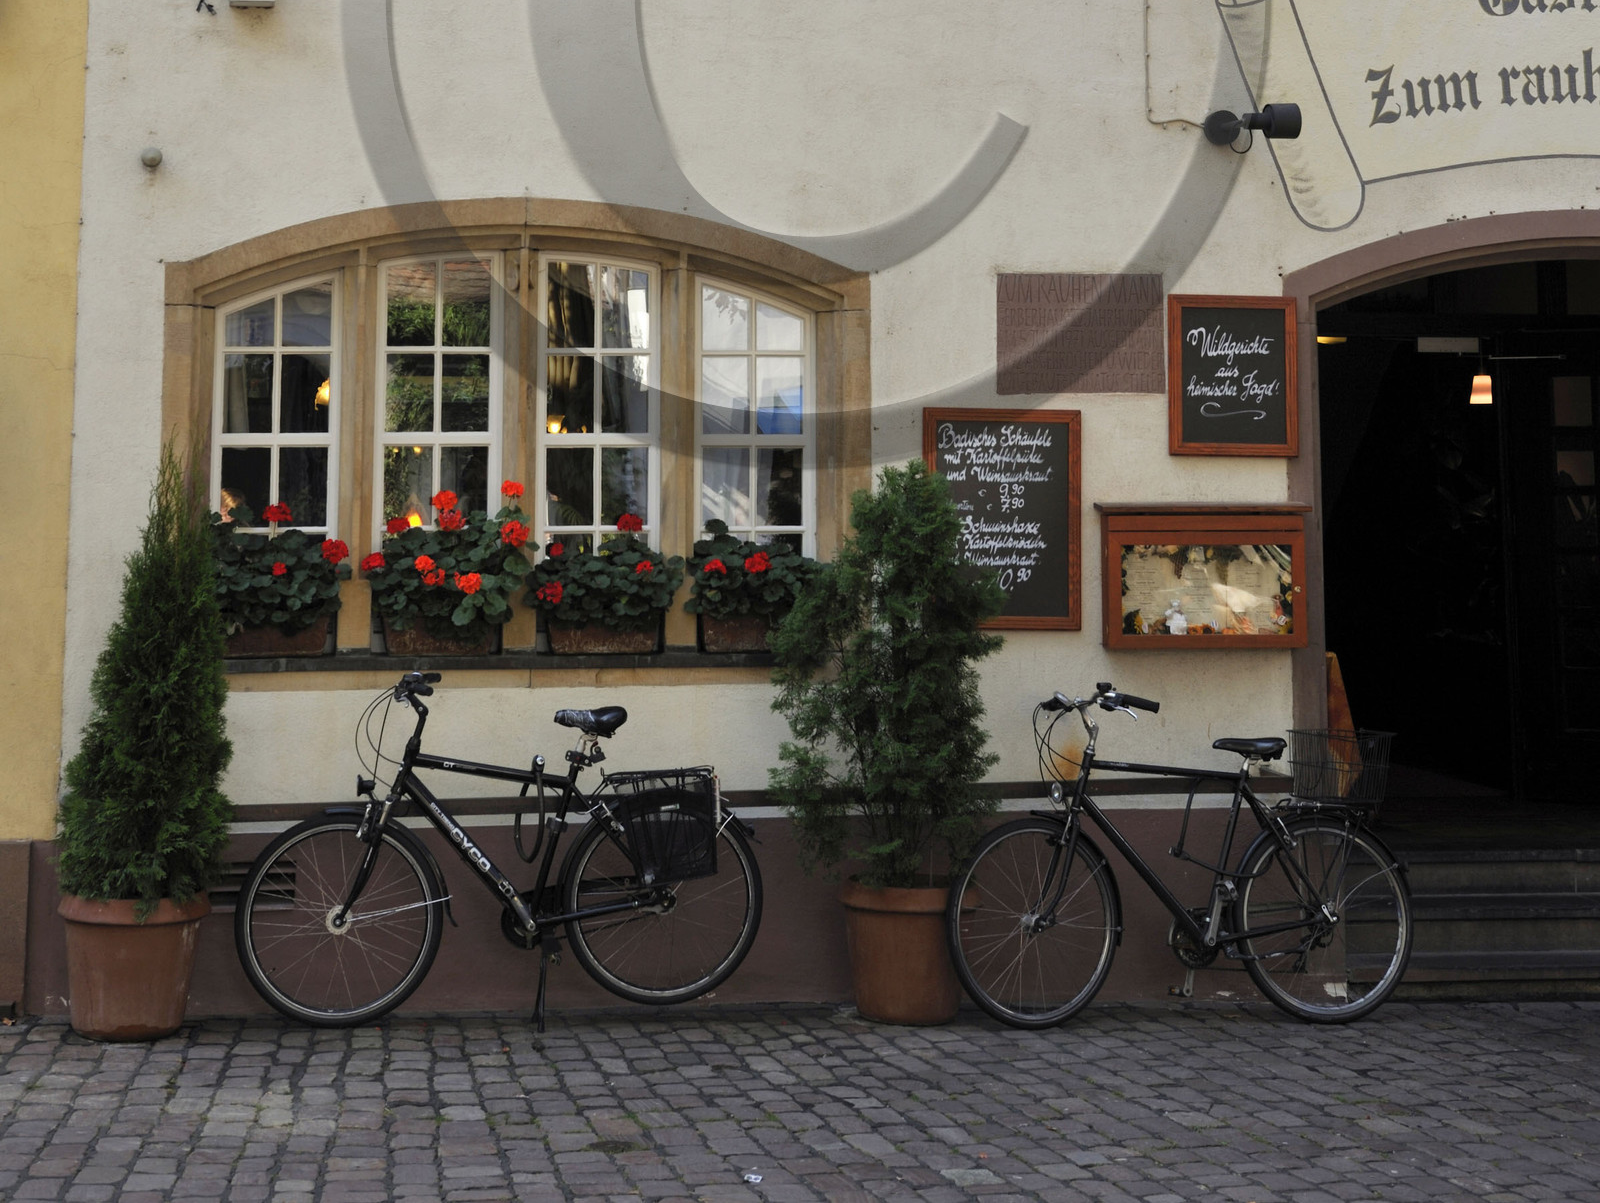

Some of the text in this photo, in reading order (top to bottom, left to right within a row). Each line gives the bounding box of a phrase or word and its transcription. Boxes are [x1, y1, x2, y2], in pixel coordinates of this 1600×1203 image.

[1364, 63, 1482, 128] Zum
[997, 273, 1163, 306] ZUM RAUHEN MANN
[1187, 325, 1275, 365] Wildgerichte
[1187, 370, 1280, 403] heimischer Jagd!
[1215, 366, 1239, 377] aus
[938, 423, 1052, 457] Badisches Schäufele
[944, 448, 964, 465] mit
[946, 466, 967, 481] und
[960, 515, 1041, 535] Schweinshaxe
[963, 533, 1047, 554] Kartoffelknödeln
[450, 827, 491, 872] CYCO
